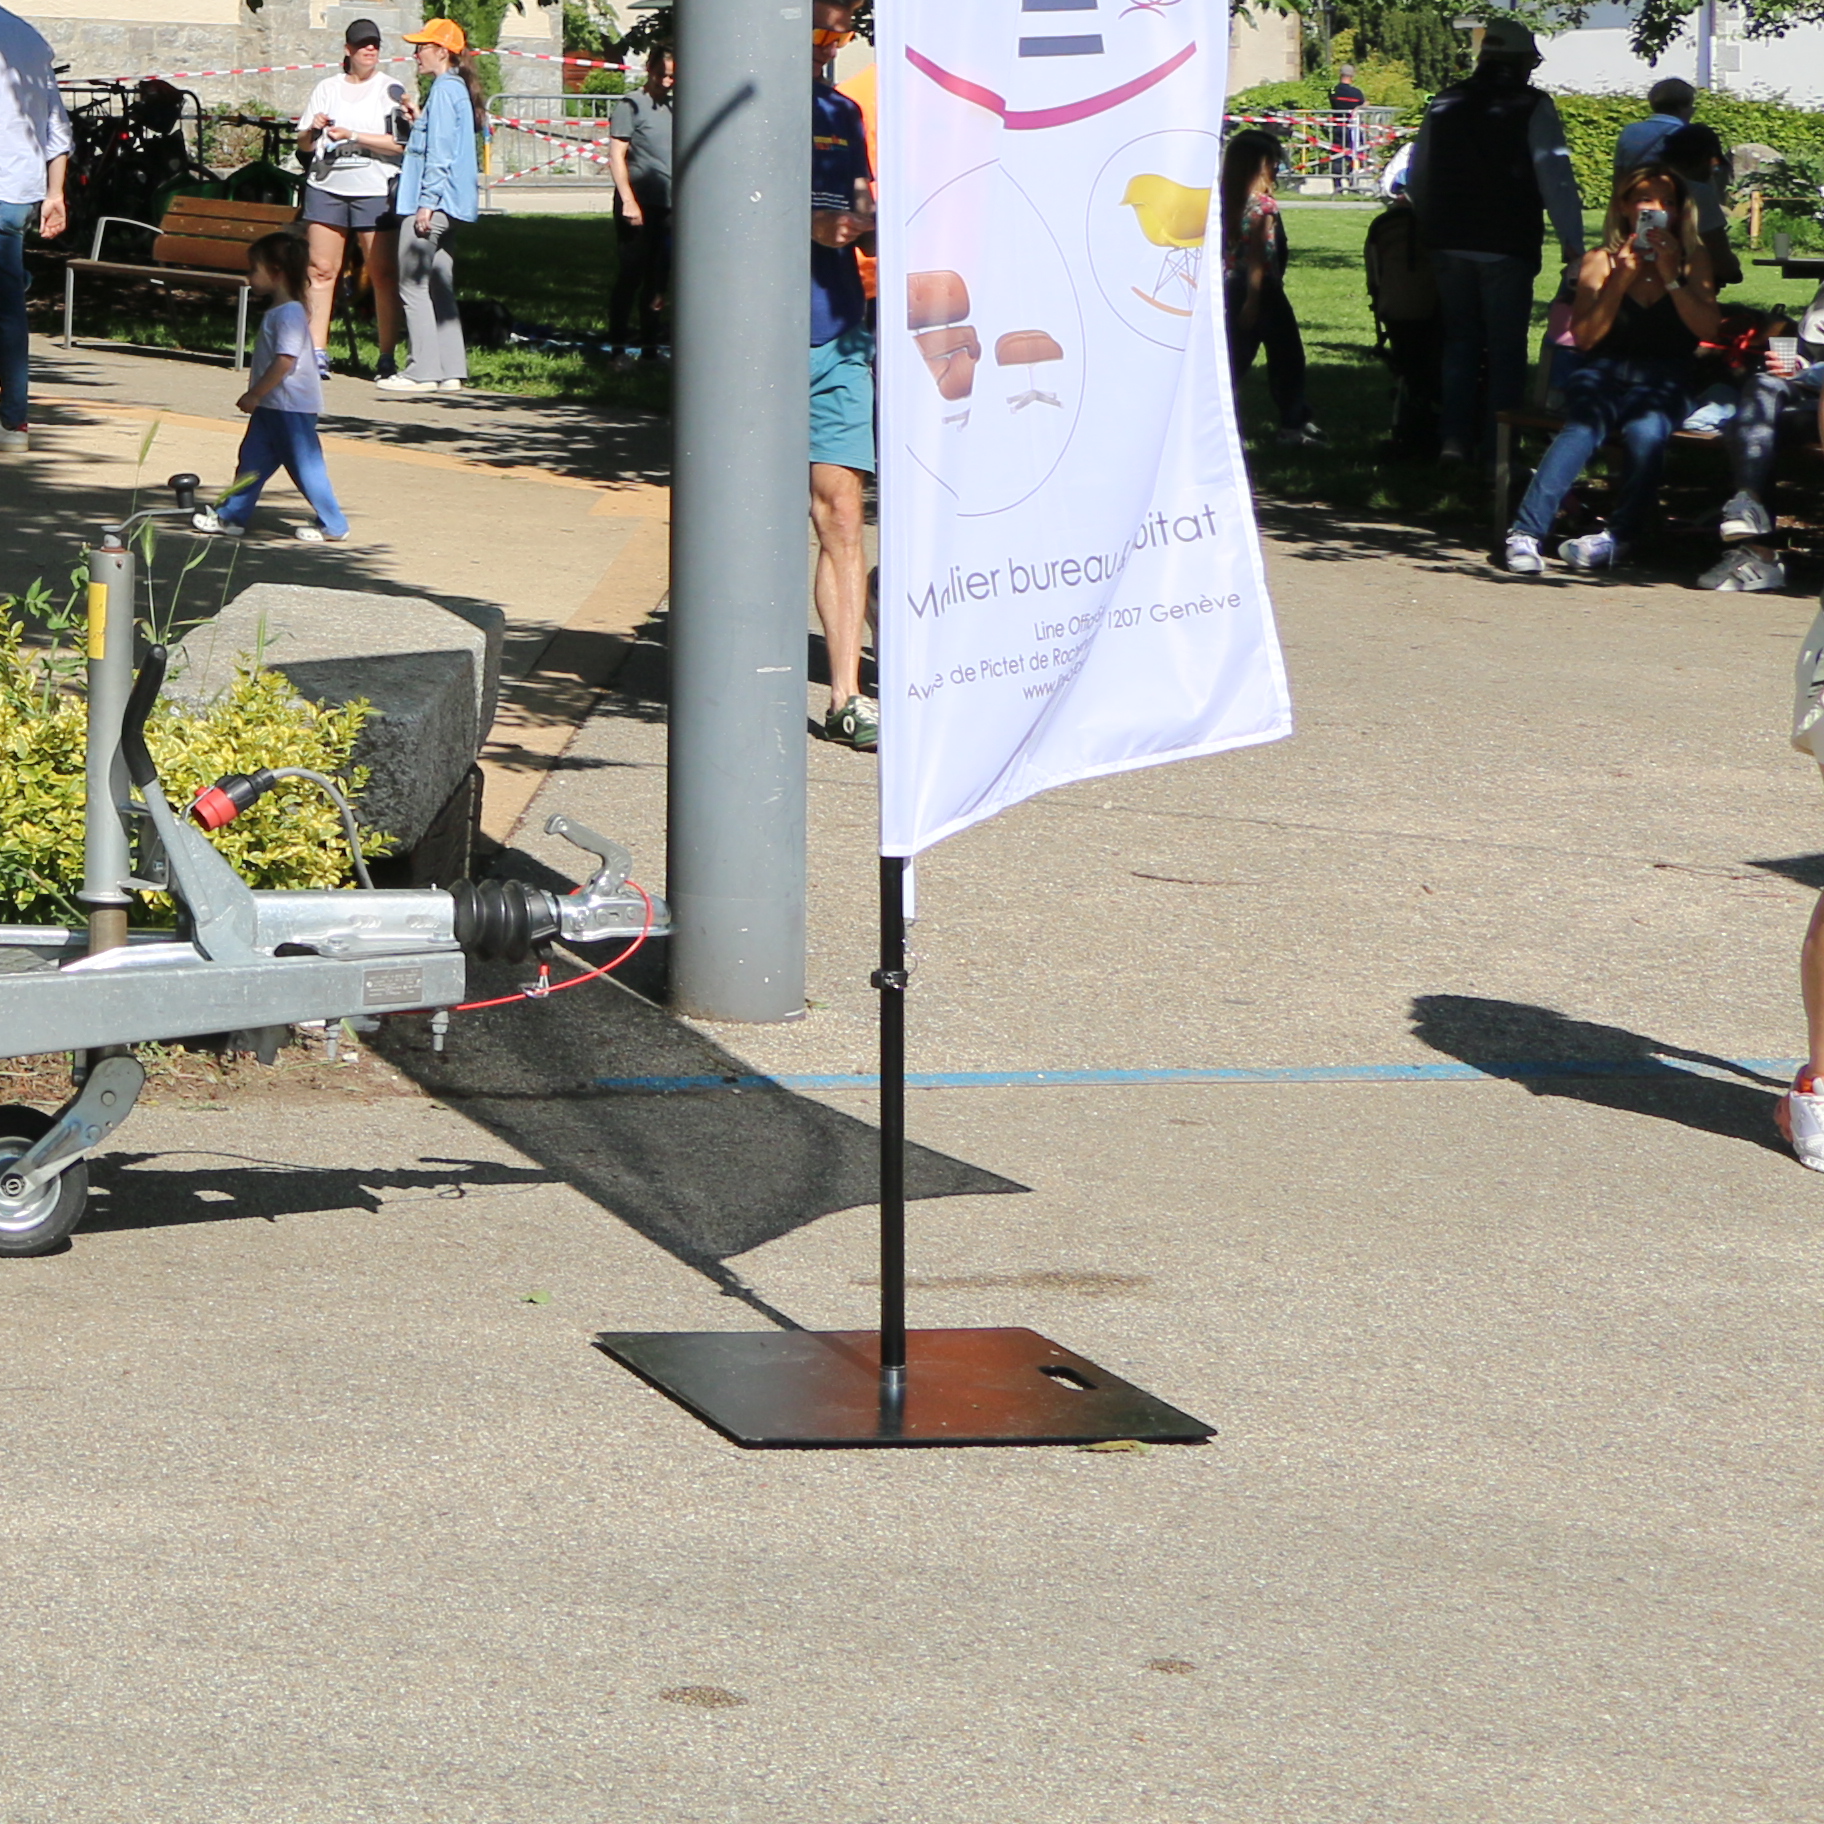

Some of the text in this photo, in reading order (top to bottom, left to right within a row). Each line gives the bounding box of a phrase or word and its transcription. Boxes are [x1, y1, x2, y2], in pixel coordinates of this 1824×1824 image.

[1007, 551, 1118, 595] bureau
[1034, 619, 1065, 642] Line
[1107, 606, 1143, 630] 1207
[1149, 589, 1242, 623] Genève
[950, 663, 976, 685] de
[979, 651, 1025, 680] Pictet
[1029, 651, 1049, 672] de
